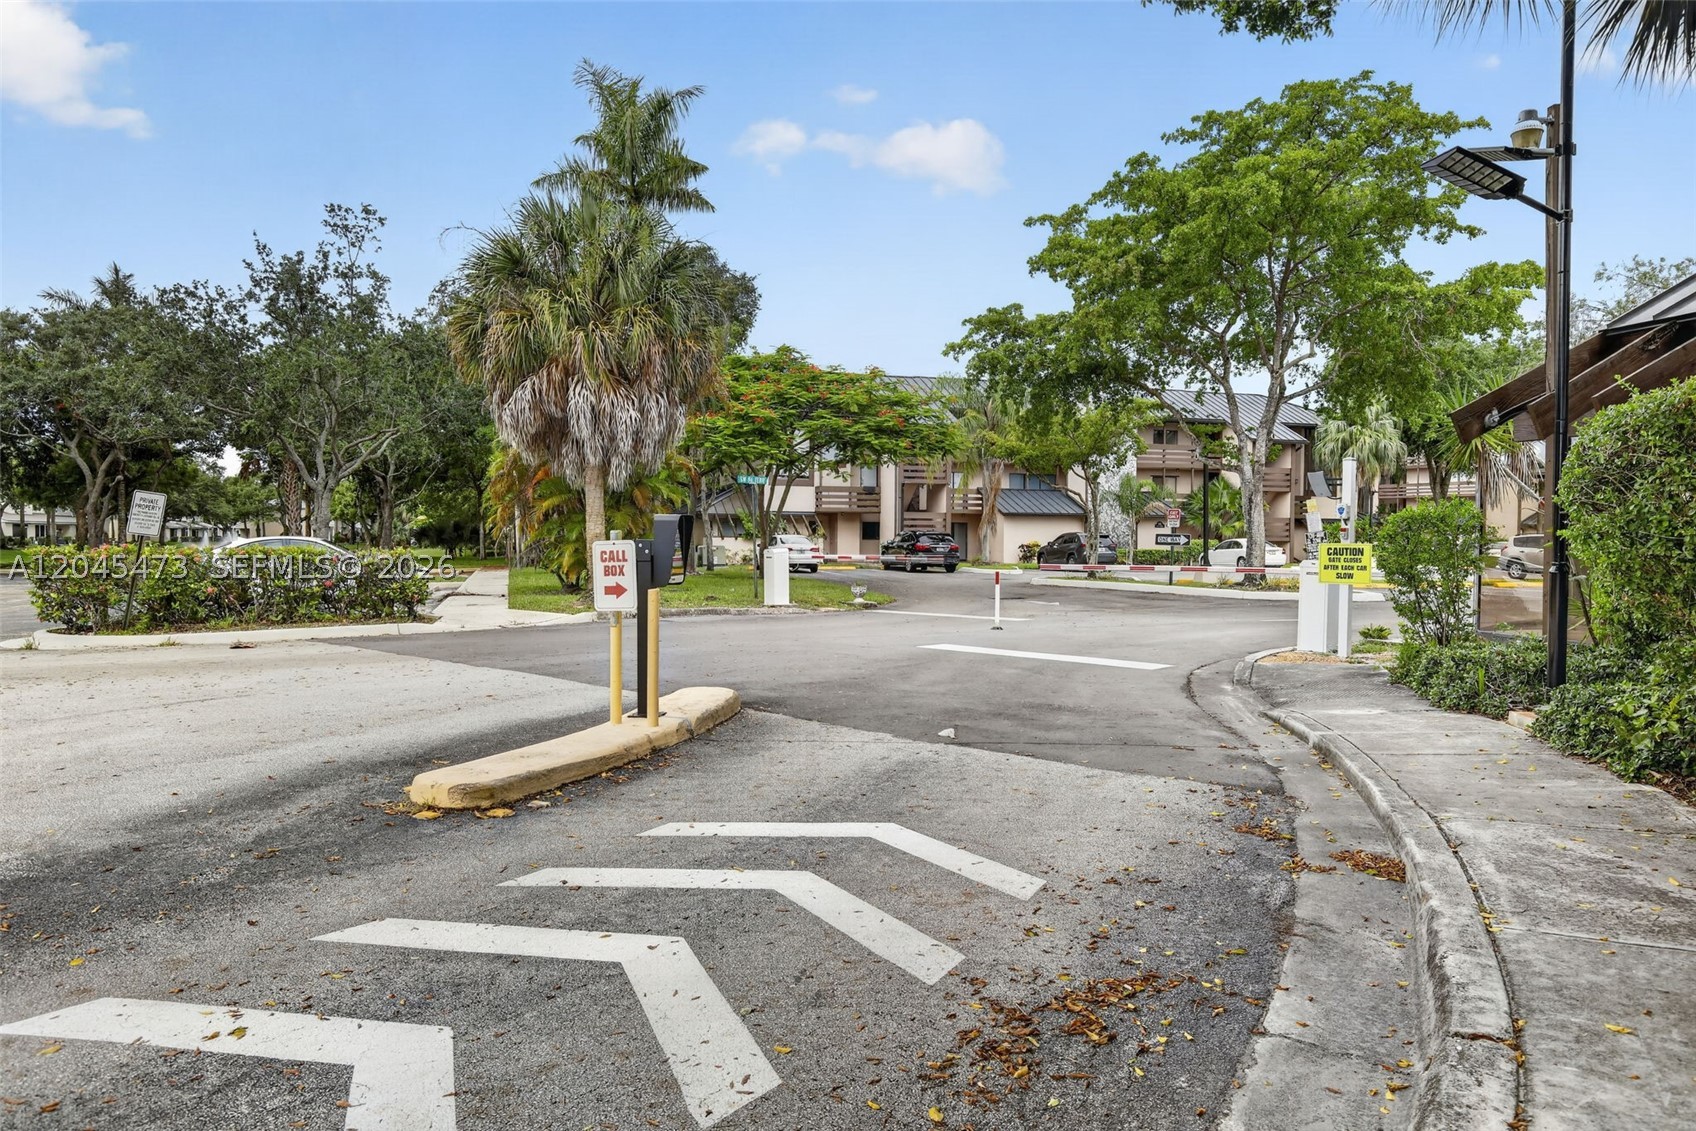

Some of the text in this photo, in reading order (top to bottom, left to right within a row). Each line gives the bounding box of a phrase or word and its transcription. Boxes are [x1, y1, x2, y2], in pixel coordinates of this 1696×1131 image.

[140, 497, 159, 506] PRIVATE
[135, 503, 161, 511] PROPERTY
[1327, 547, 1364, 556] CAUTION
[600, 550, 628, 563] CALL
[603, 565, 625, 577] BOX
